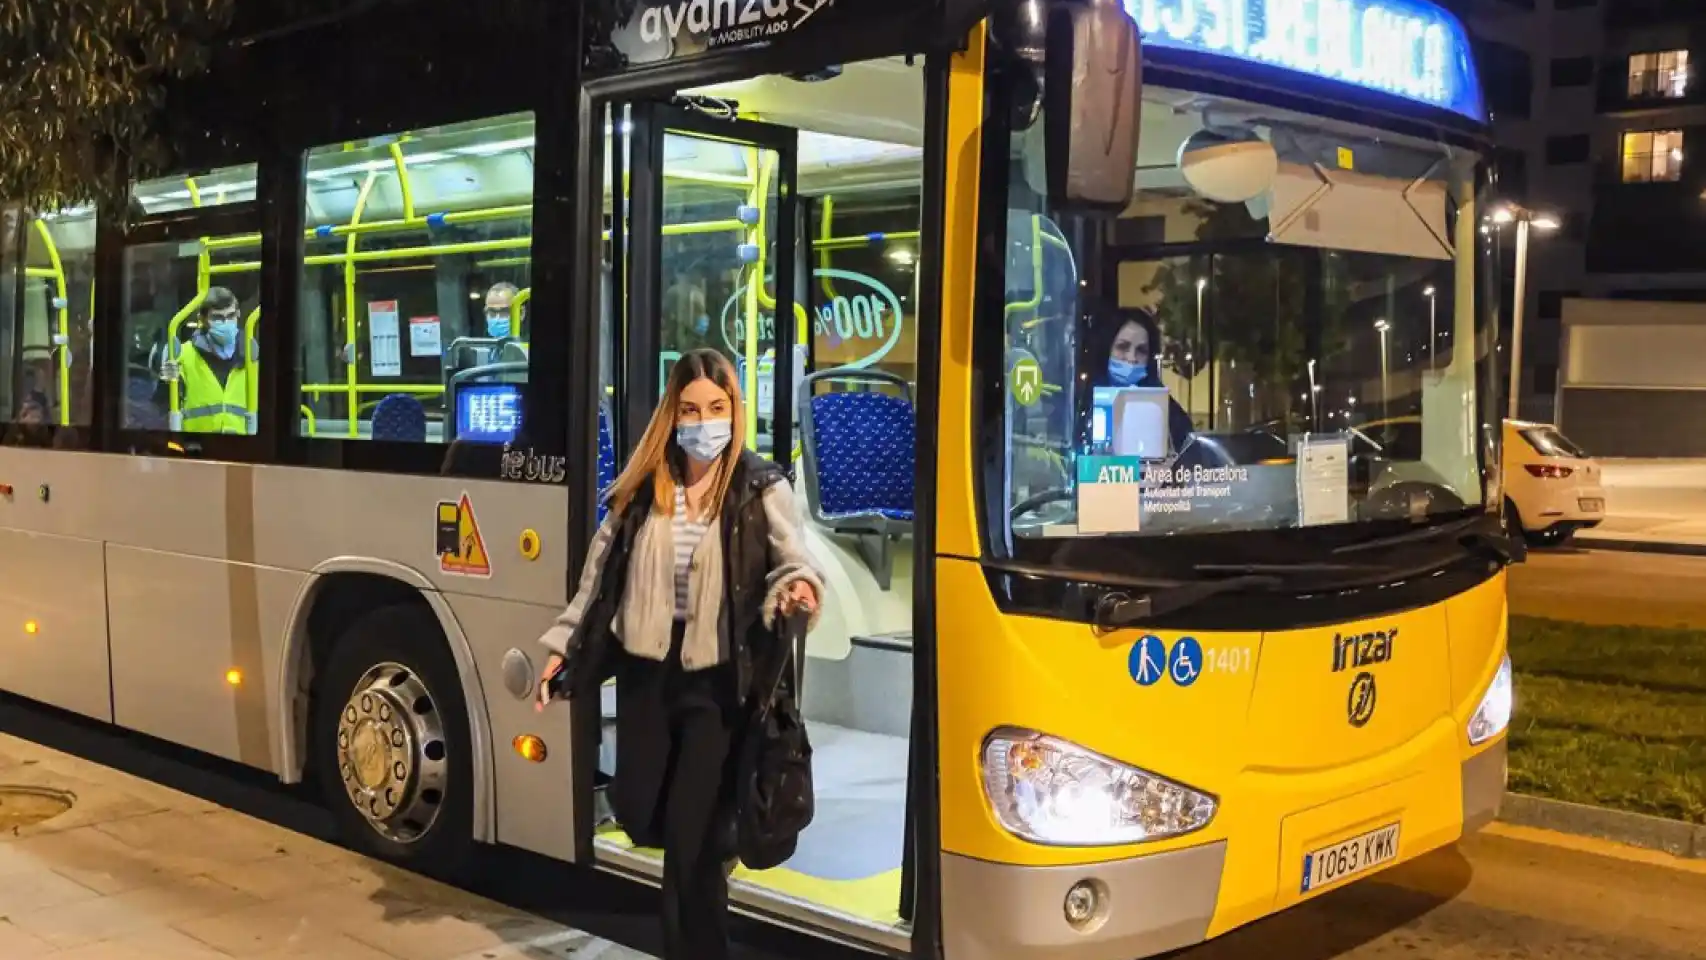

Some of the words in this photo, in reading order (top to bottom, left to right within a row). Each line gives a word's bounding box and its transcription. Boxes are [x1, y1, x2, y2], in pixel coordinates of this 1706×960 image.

[640, 0, 788, 43] avanza
[718, 25, 764, 43] MOBILITY
[765, 20, 788, 35] ADO
[1098, 465, 1135, 484] ATM
[1175, 466, 1191, 483] de
[1193, 463, 1248, 484] Barcelona
[1143, 487, 1180, 499] Autoritat
[1181, 486, 1195, 498] del
[1197, 485, 1231, 498] Transport
[1206, 647, 1250, 673] 1401
[1317, 841, 1360, 882] 1063
[1363, 827, 1396, 865] KWK
